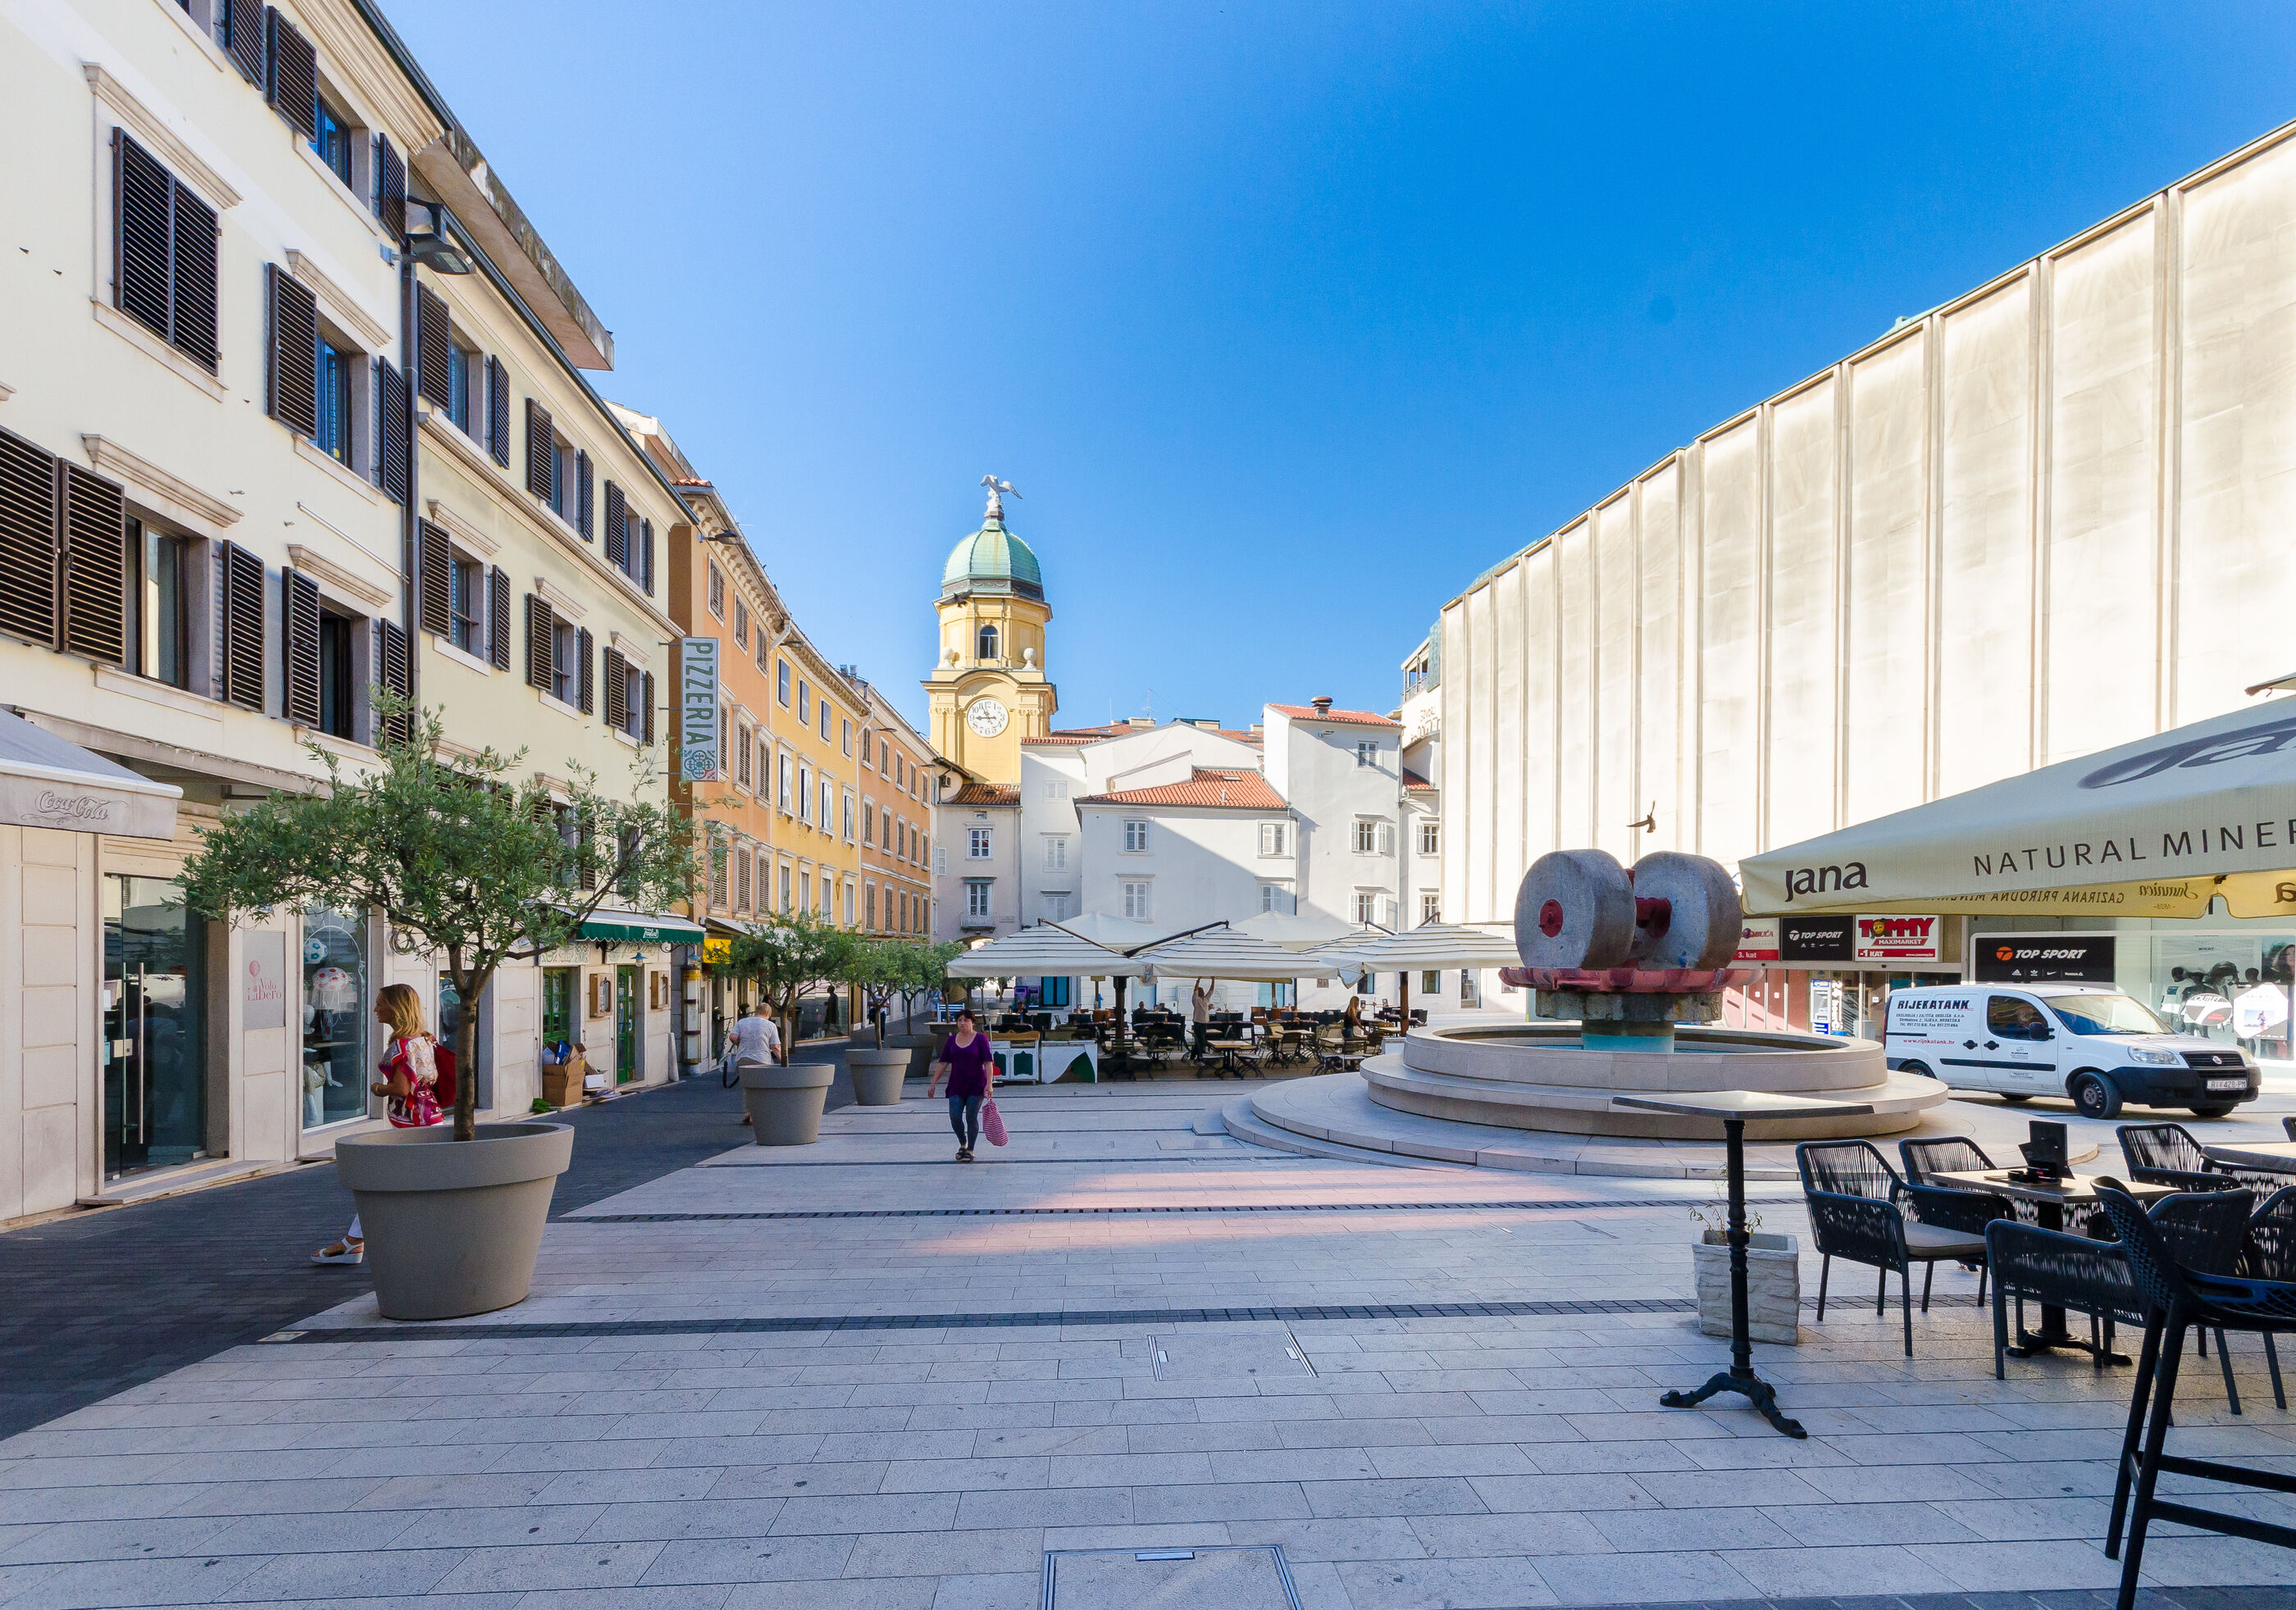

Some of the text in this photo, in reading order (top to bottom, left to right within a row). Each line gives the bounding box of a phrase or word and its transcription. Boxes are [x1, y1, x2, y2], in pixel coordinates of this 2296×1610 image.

[686, 642, 713, 745] PIZZERIA
[34, 789, 120, 821] Coca-Cola
[1974, 837, 2147, 877] NATURAL
[1784, 861, 1870, 903] Jana
[1801, 931, 1843, 939] TOP SPORT
[1860, 949, 1868, 957] -1
[2015, 949, 2087, 959] TOP SPORT
[1897, 999, 1970, 1010] RIJEKATANK
